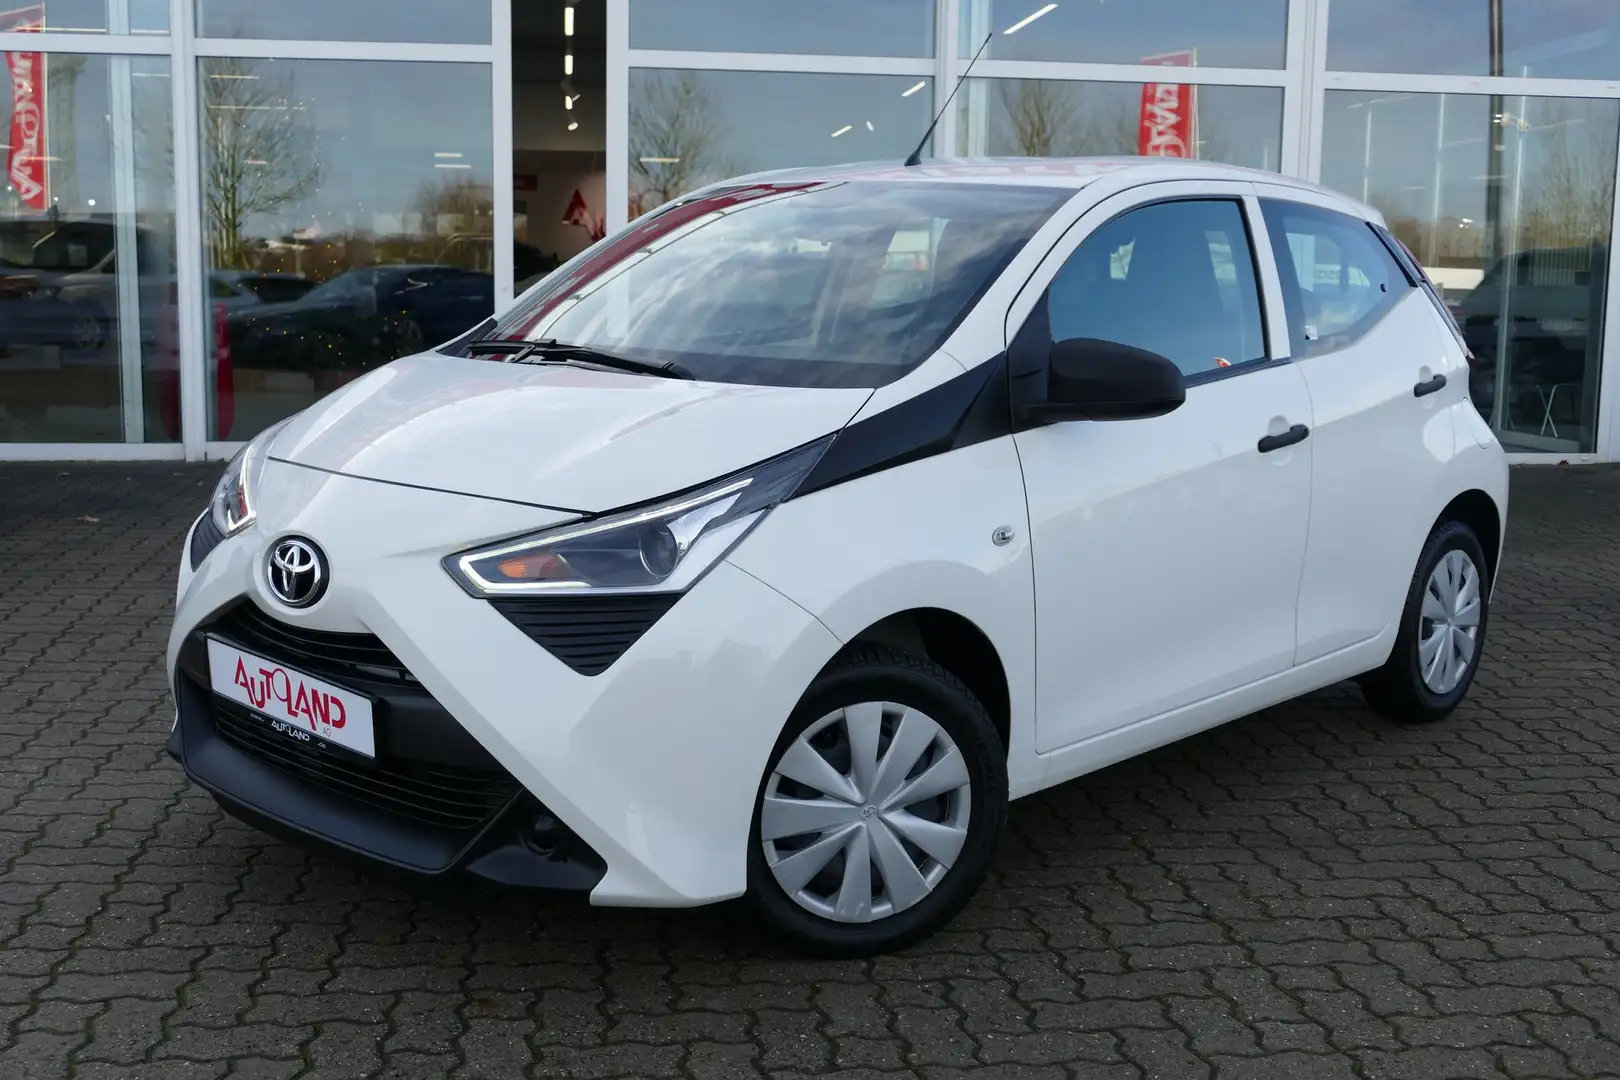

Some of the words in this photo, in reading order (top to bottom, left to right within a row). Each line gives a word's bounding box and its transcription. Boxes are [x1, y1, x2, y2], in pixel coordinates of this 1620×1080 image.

[234, 655, 346, 731] AUTOLAND
[271, 720, 310, 742] AUTOLAND
[322, 727, 332, 738] AG
